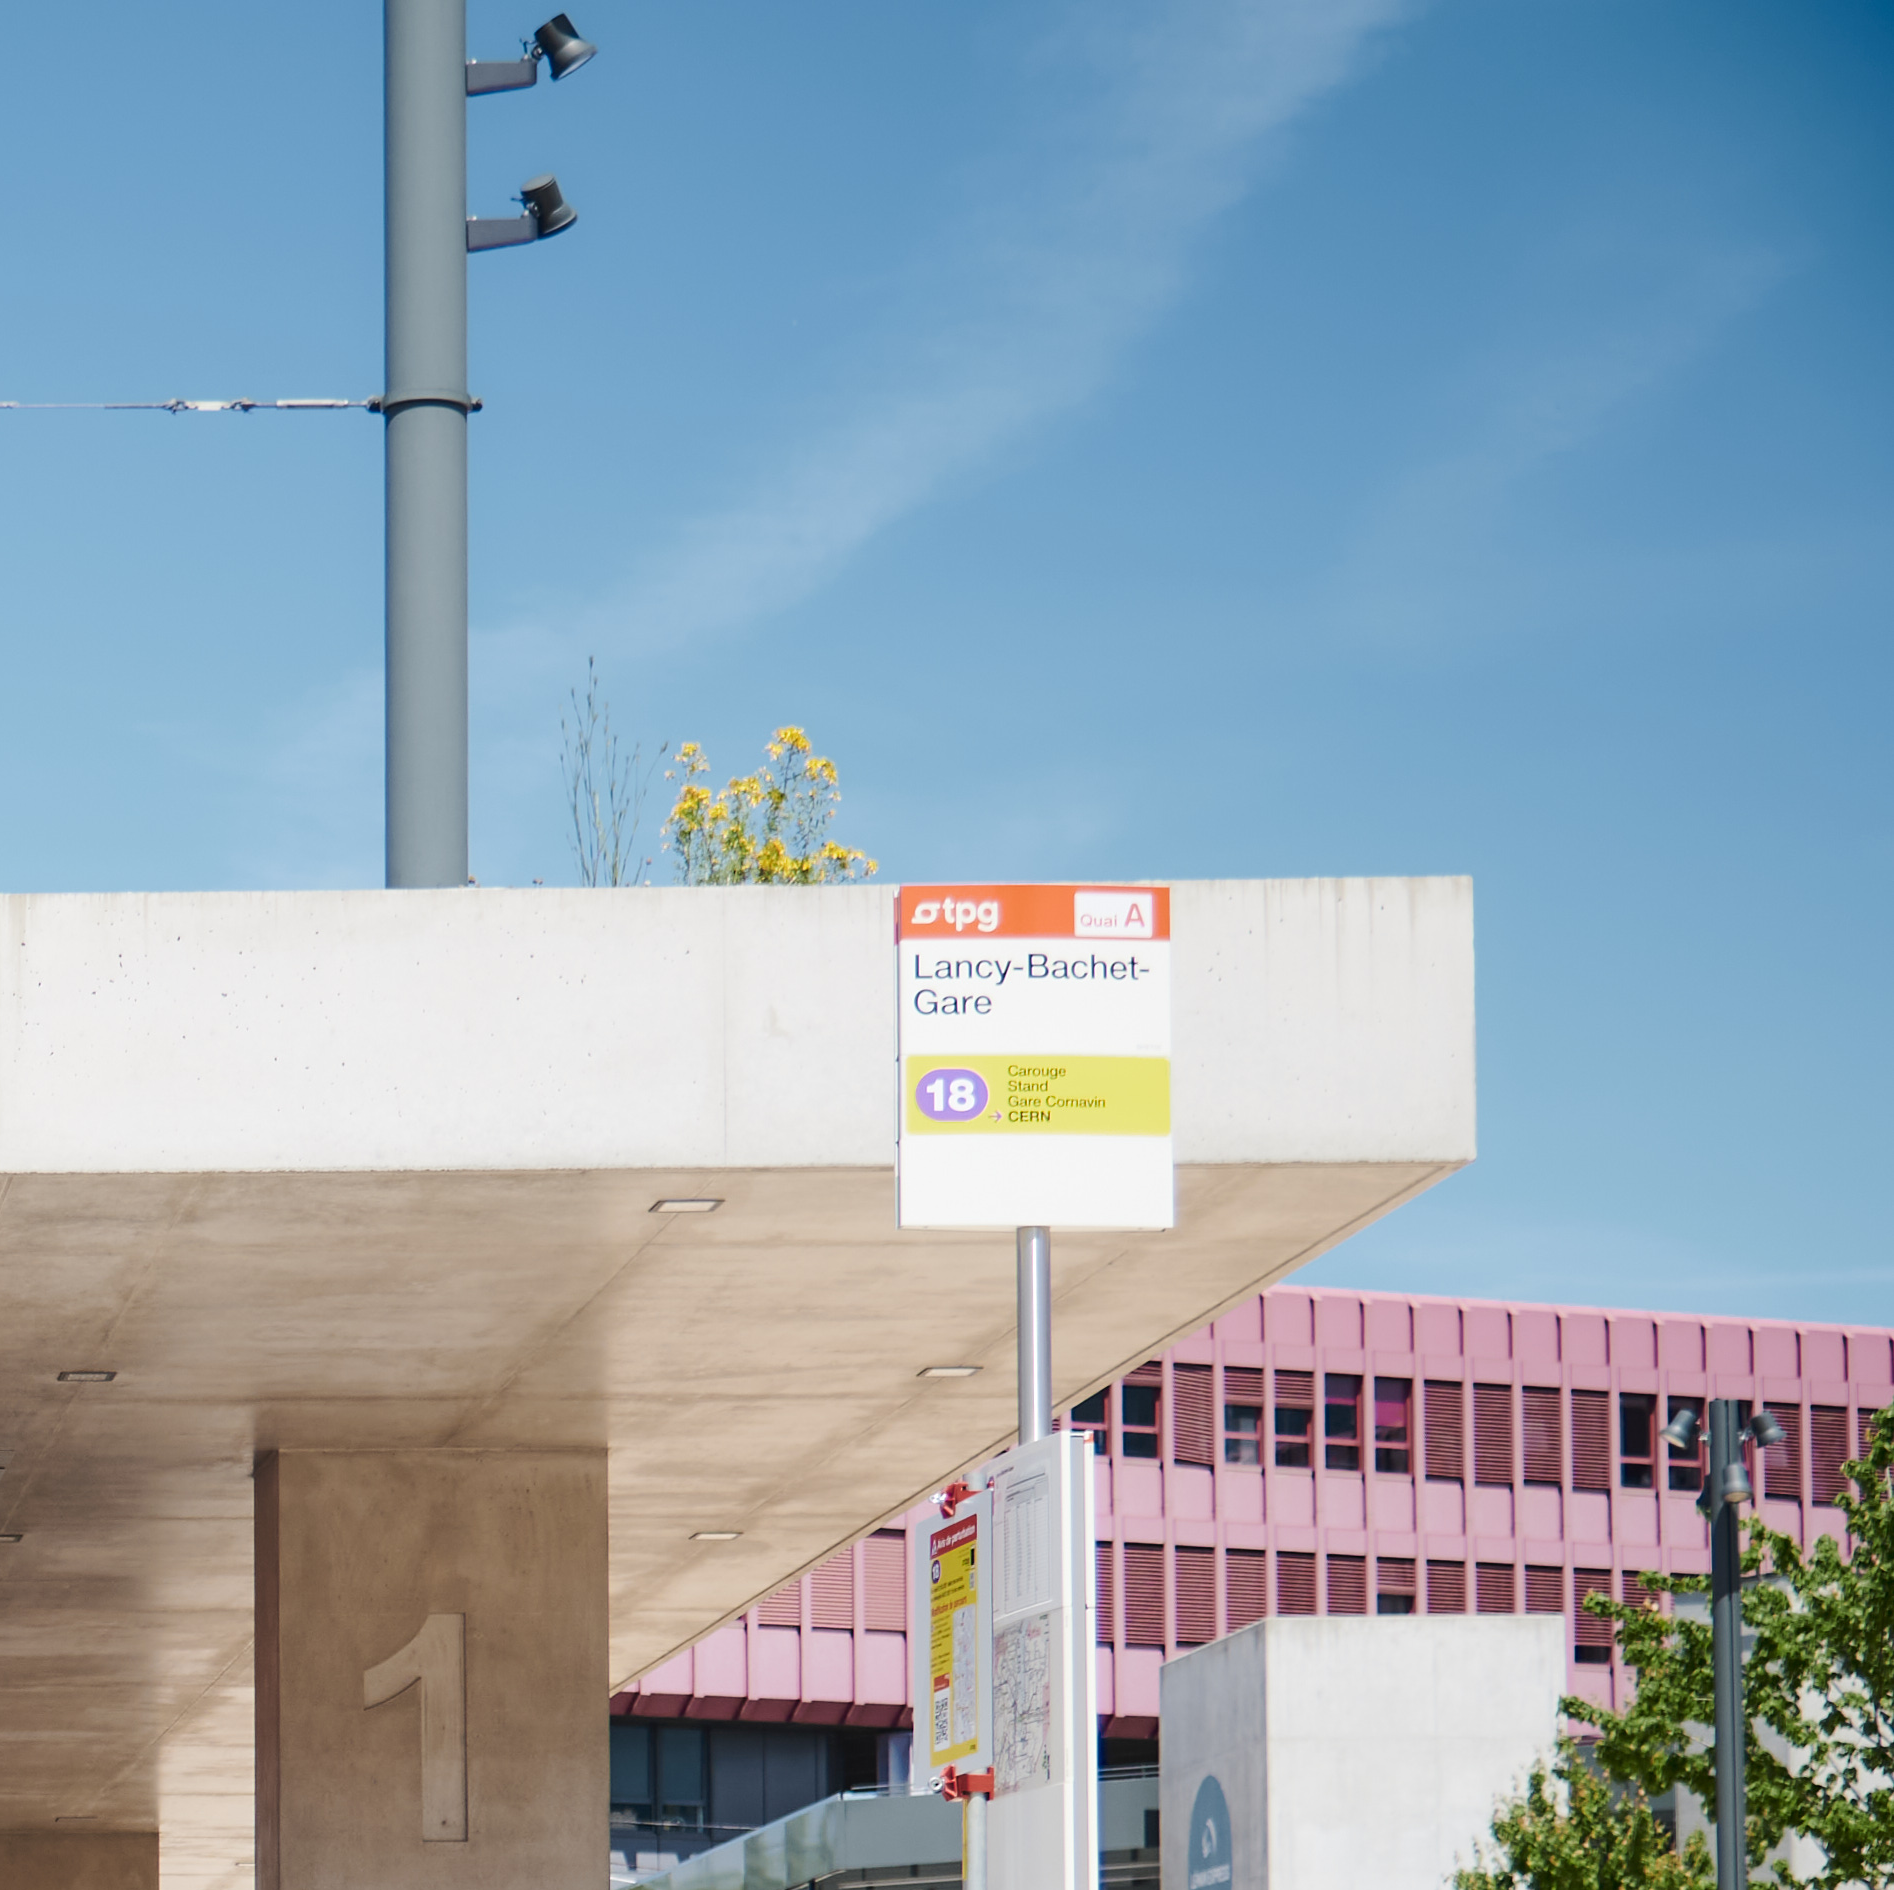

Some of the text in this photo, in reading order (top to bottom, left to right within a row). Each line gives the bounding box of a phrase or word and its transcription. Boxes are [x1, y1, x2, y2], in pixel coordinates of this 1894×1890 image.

[942, 898, 999, 932] tpg
[1080, 903, 1145, 928] Quai A
[914, 953, 1150, 985] Lancy-Bachet-
[913, 989, 992, 1015] Gare
[1008, 1064, 1067, 1079] Carouge
[926, 1078, 975, 1113] 18
[1008, 1080, 1049, 1092] Stand
[1008, 1095, 1106, 1108] Gare Cornavin
[1008, 1110, 1051, 1123] CERN
[363, 1612, 468, 1842] 1
